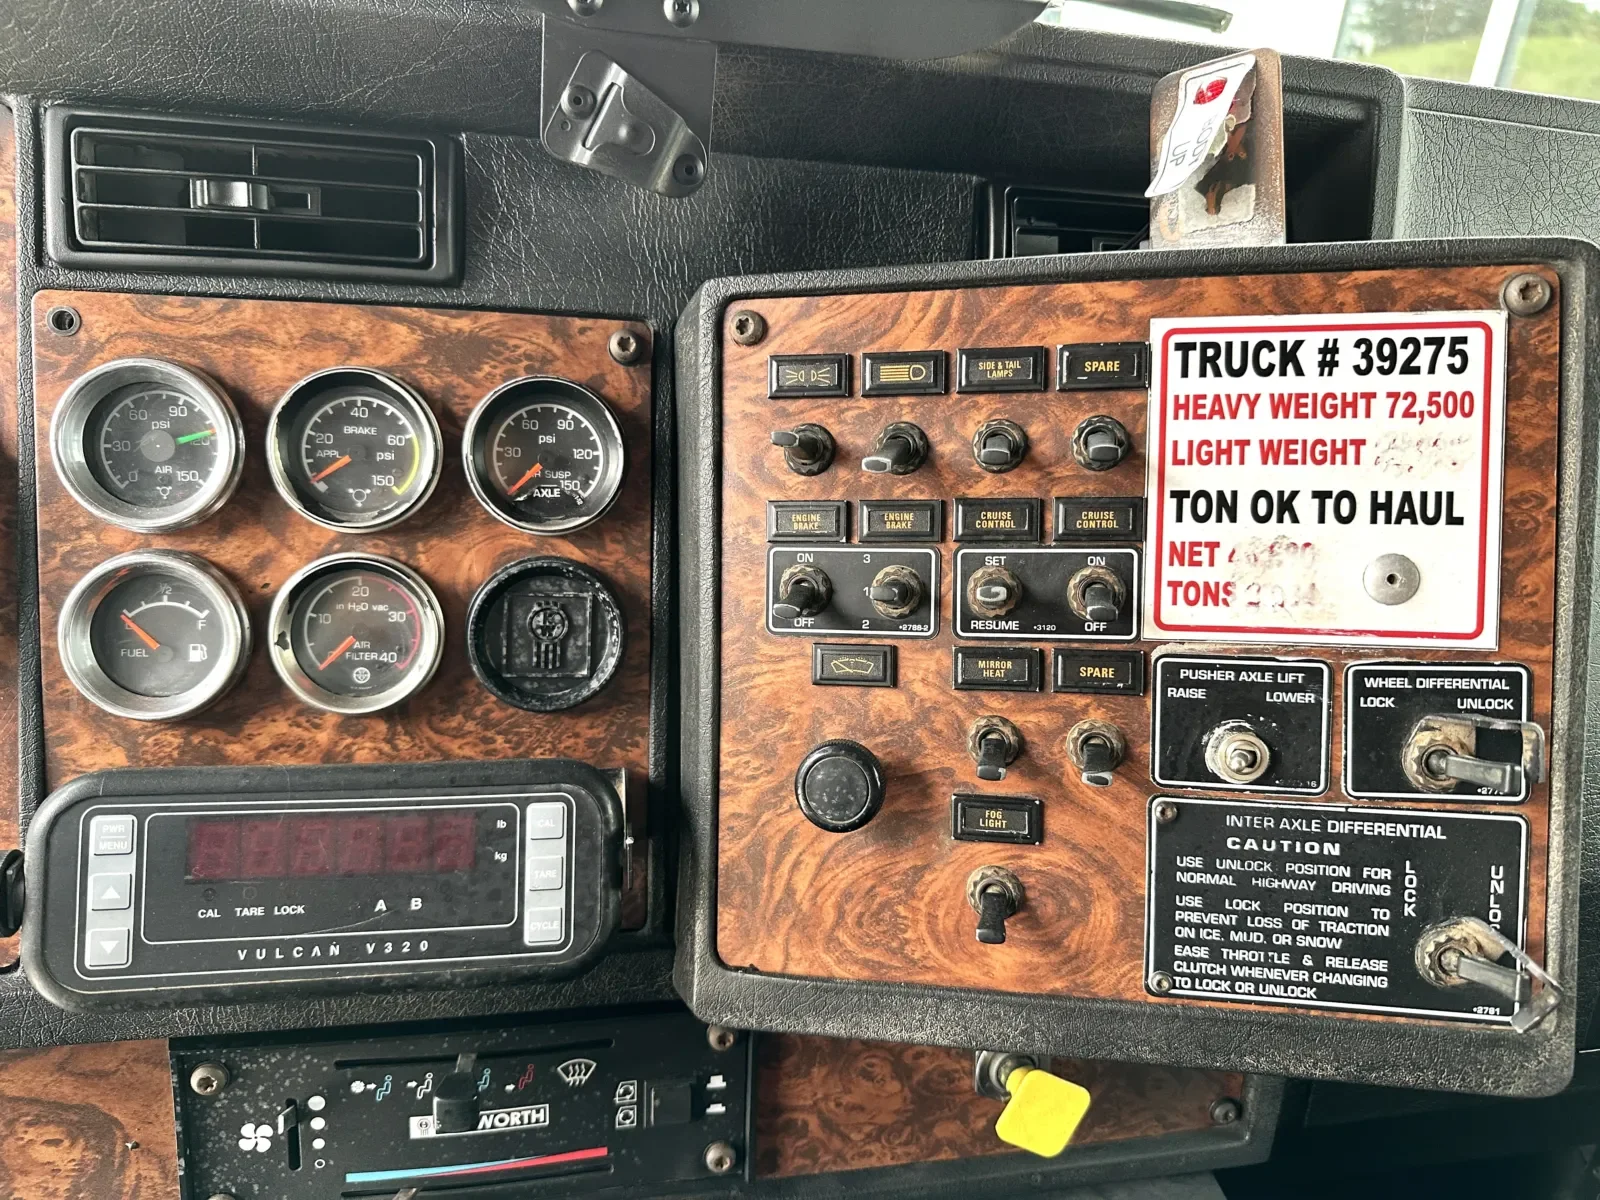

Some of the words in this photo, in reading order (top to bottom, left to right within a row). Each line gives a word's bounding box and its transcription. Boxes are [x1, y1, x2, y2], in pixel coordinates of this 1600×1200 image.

[1169, 140, 1191, 167] UP
[1174, 339, 1306, 379] TRUCK
[1317, 338, 1340, 377] #
[1352, 336, 1469, 376] 39275
[978, 362, 996, 370] SIDE
[997, 361, 1003, 370] &
[1005, 361, 1022, 369] TAIL
[1084, 361, 1120, 373] SPARE
[987, 370, 1013, 378] LAMPS
[168, 406, 188, 417] 90
[350, 407, 368, 418] 40
[1172, 393, 1261, 420] HEAVY
[1269, 392, 1377, 419] WEIGHT
[1386, 391, 1475, 425] 72,500
[129, 410, 148, 421] 60
[151, 420, 171, 430] psi
[343, 426, 377, 435] BRAKE
[522, 420, 539, 431] 60
[557, 420, 575, 431] 90
[316, 434, 334, 445] 20
[387, 436, 406, 446] 60
[538, 434, 556, 444] psi
[112, 441, 131, 452] 30
[316, 450, 342, 458] APPL
[376, 451, 395, 462] psi
[504, 447, 521, 458] 30
[573, 449, 593, 460] 120
[1171, 439, 1250, 466] LIGHT
[1259, 439, 1366, 466] WEIGHT
[154, 466, 173, 474] AIR
[545, 471, 572, 479] SUSP
[128, 471, 138, 482] 0
[176, 471, 199, 482] 150
[372, 475, 395, 486] 150
[560, 480, 581, 491] 150
[533, 488, 561, 498] AXLE
[1169, 490, 1238, 523] TON
[1250, 489, 1301, 524] OK
[1311, 490, 1357, 525] TO
[1369, 491, 1464, 526] HAUL
[792, 514, 821, 522] ENGINE
[884, 512, 914, 521] ENGINE
[980, 511, 1012, 520] CRUISE
[1082, 511, 1115, 520] CRUISE
[794, 521, 819, 530] BRAKE
[886, 520, 912, 529] BRAKE
[976, 520, 1016, 529] CONTROL
[1077, 520, 1119, 529] CONTROL
[797, 553, 814, 563] ON
[863, 554, 871, 564] 3
[1168, 541, 1220, 567] NET
[984, 556, 1007, 566] SET
[1087, 556, 1106, 566] ON
[352, 586, 370, 597] 20
[863, 586, 870, 597] 1
[319, 613, 332, 624] 10
[388, 612, 406, 622] 30
[197, 620, 206, 630] F
[794, 618, 815, 628] OFF
[862, 619, 870, 630] 2
[970, 620, 1020, 631] RESUME
[1084, 622, 1107, 632] OFF
[354, 641, 371, 649] AIR
[121, 648, 149, 658] FUEL
[346, 652, 378, 661] FILTER
[379, 652, 397, 663] 40
[978, 660, 1013, 669] MIRROR
[983, 669, 1006, 678] HEAT
[1079, 667, 1115, 678] SPARE
[1180, 669, 1235, 681] PUSHER
[1238, 671, 1273, 683] AXLE
[1277, 673, 1306, 684] LIFT
[1364, 677, 1413, 689] WHEEL
[1416, 678, 1510, 690] DIFFERENTIAL
[1167, 687, 1207, 699] RAISE
[1265, 691, 1315, 704] LOWER
[1359, 696, 1395, 708] LOCK
[1457, 698, 1514, 710] UNLOCK
[985, 810, 1003, 820] FOG
[102, 824, 125, 833] PWR
[496, 819, 507, 829] lb
[537, 820, 556, 828] CAL
[979, 818, 1007, 829] LIGHT
[1226, 815, 1275, 829] INTER
[1279, 817, 1321, 832] AXLE
[1327, 820, 1447, 839] DIFFERENTIAL
[99, 841, 128, 850] MENU
[1226, 837, 1341, 856] CAUTION
[494, 851, 508, 862] kg
[1176, 855, 1204, 868] USE
[1216, 858, 1273, 873] UNLOCK
[1285, 862, 1351, 878] POSITION
[1362, 867, 1392, 880] FOR
[534, 869, 557, 879] TARE
[1176, 871, 1237, 887] NORMAL
[1251, 877, 1316, 892] HIGHWAY
[1331, 881, 1392, 896] DRIVING
[1404, 860, 1417, 917] LOCK
[374, 899, 388, 912] A
[410, 897, 423, 910] B
[1175, 895, 1203, 908] USE
[1225, 898, 1261, 911] LOCK
[1283, 902, 1349, 918] POSITION
[1371, 907, 1390, 921] TO
[198, 909, 222, 918] CAL
[235, 907, 265, 917] TARE
[273, 905, 305, 916] LOCK
[530, 920, 560, 931] CYCLE
[1175, 911, 1239, 926] PREVENT
[1247, 915, 1283, 929] LOSS
[1291, 919, 1310, 932] OF
[1318, 920, 1389, 937] TRACTION
[1174, 926, 1196, 939] ON
[1272, 933, 1292, 946] OR
[1296, 935, 1343, 950] SNOW
[1174, 944, 1210, 959] EASE
[1302, 954, 1314, 966] &
[1325, 956, 1388, 972] RELEASE
[1173, 960, 1227, 976] CLUTCH
[1230, 965, 1309, 982] WHENEVER
[1312, 971, 1388, 988] CHANGING
[1173, 976, 1191, 989] TO
[1194, 978, 1231, 992] LOCK
[1234, 981, 1255, 994] OR
[1258, 983, 1317, 999] UNLOCK
